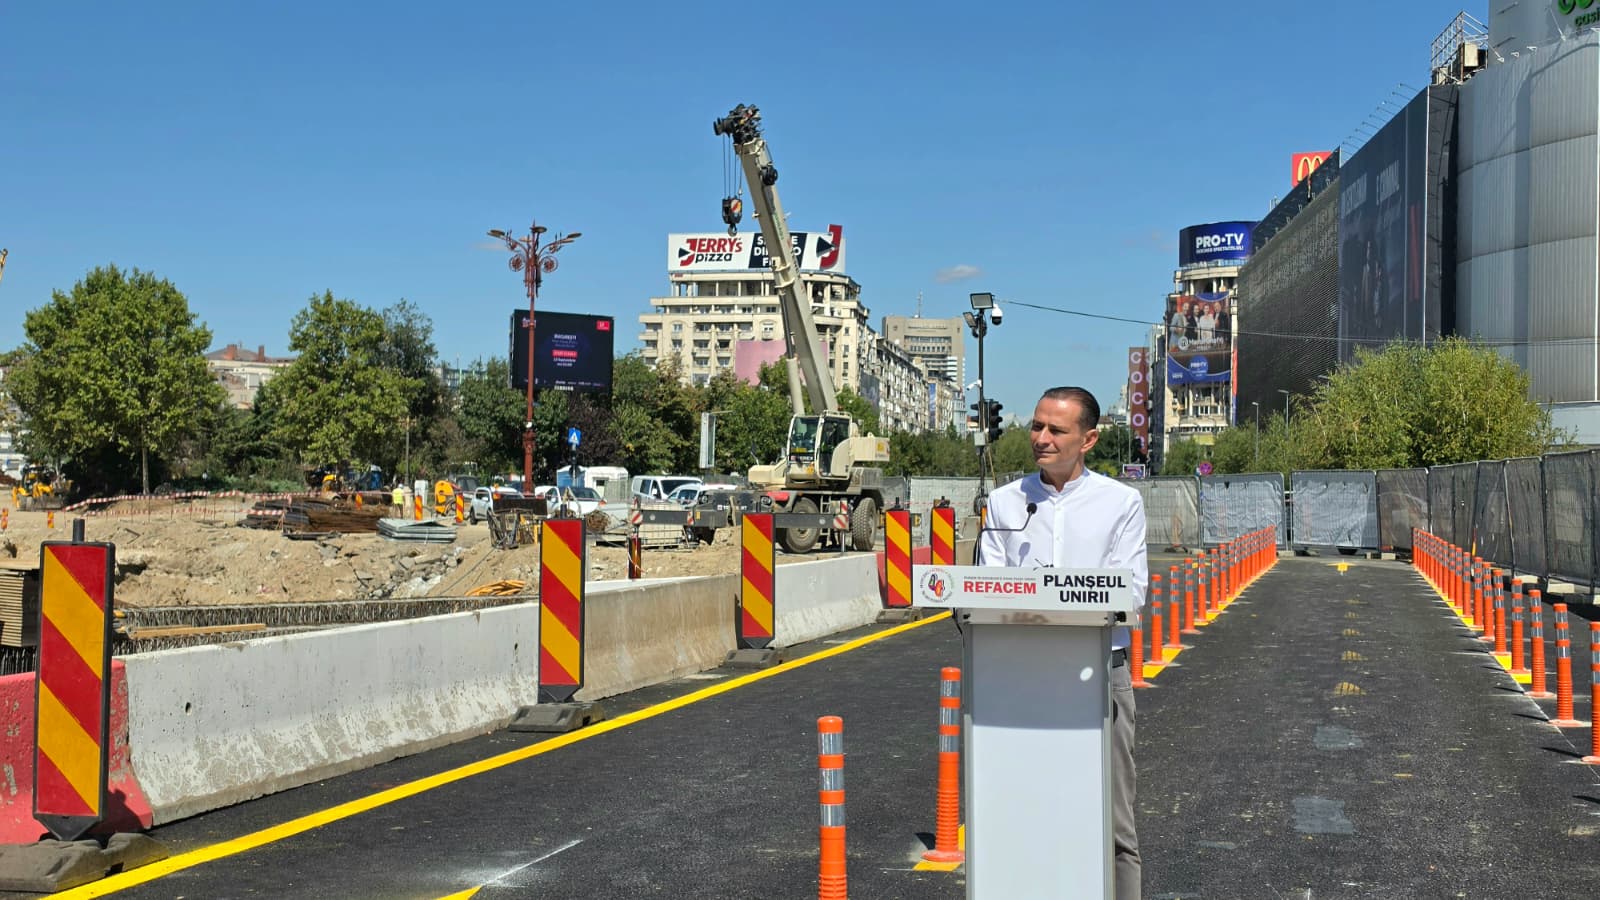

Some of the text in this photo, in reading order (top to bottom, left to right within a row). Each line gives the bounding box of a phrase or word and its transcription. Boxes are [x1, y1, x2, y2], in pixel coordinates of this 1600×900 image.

[695, 252, 733, 264] pizza
[963, 580, 1037, 595] REFACEM
[1059, 590, 1109, 604] UNIRII
